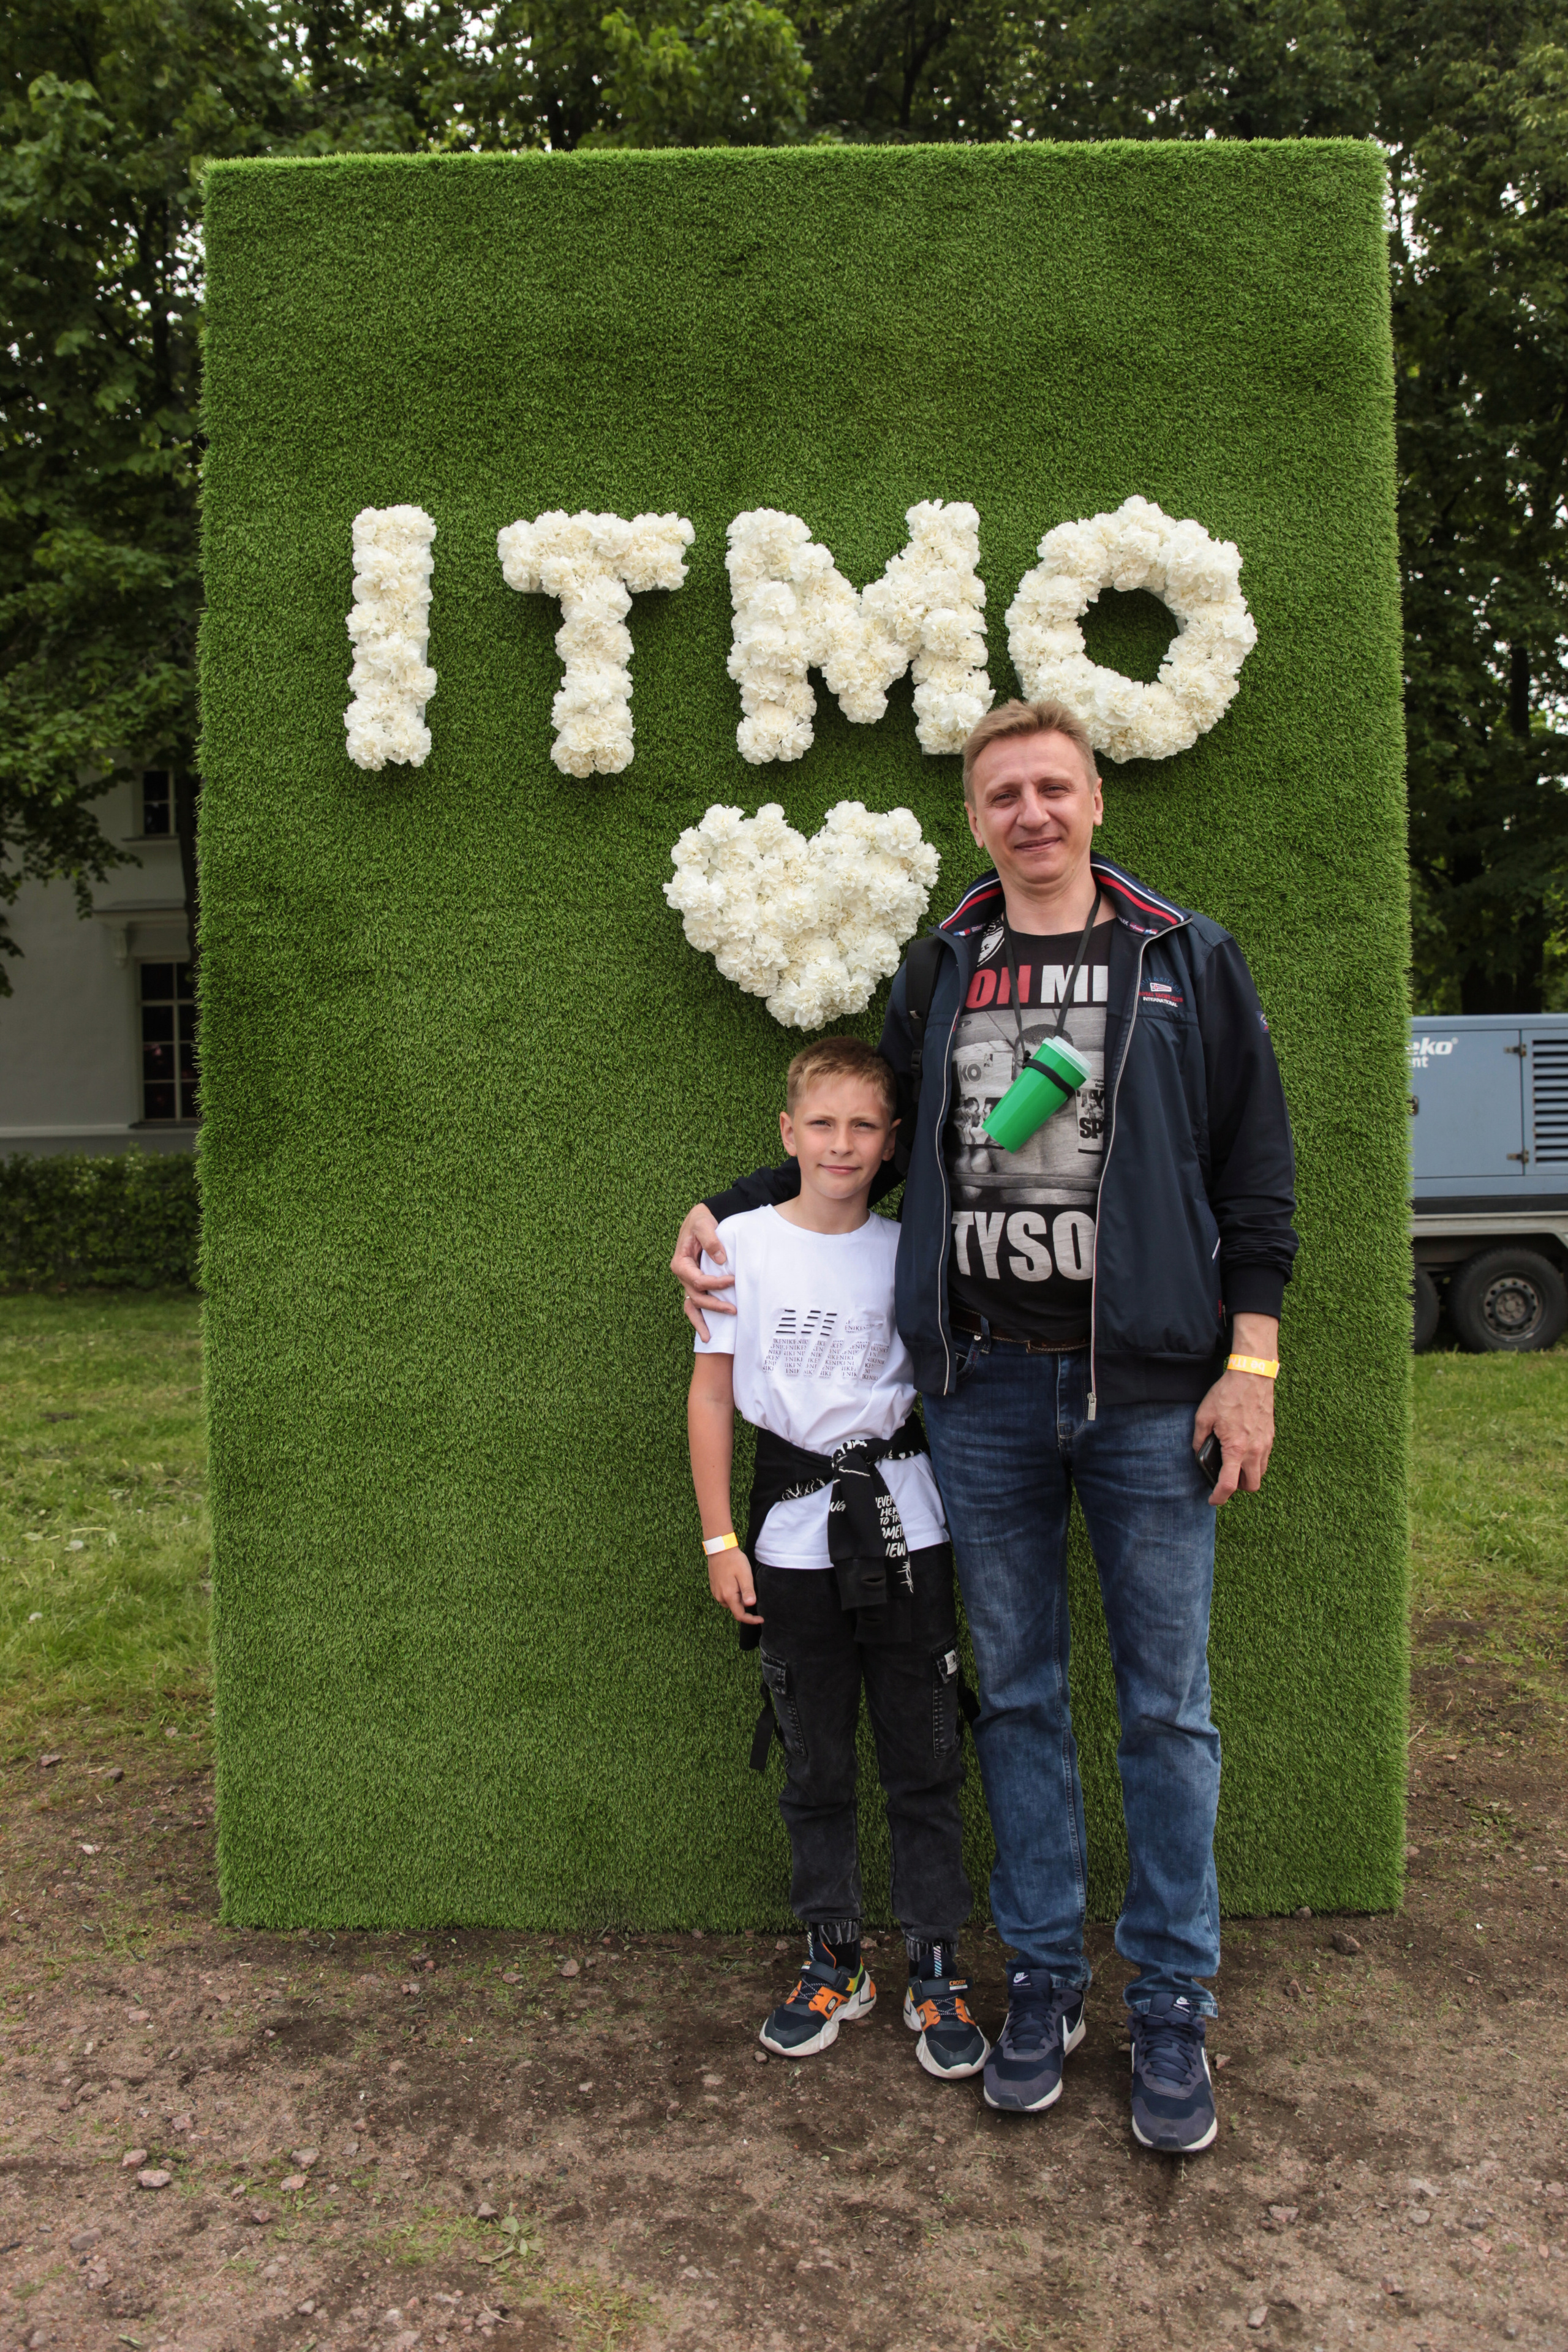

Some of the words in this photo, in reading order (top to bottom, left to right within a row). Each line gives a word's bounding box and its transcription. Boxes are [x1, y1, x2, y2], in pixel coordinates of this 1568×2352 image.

[344, 494, 1257, 778] ITMO
[965, 965, 1031, 1008] ON
[1041, 965, 1108, 1003] MI
[1143, 997, 1178, 1008] INTERNATIONAL
[1405, 1037, 1453, 1055] eko
[958, 1064, 982, 1082] KO
[1079, 1117, 1104, 1139] SP
[951, 1211, 1096, 1281] TYSO
[1229, 1357, 1246, 1368] ITM
[875, 1494, 896, 1509] EVER
[880, 1517, 889, 1525] TO
[891, 1515, 900, 1523] TR
